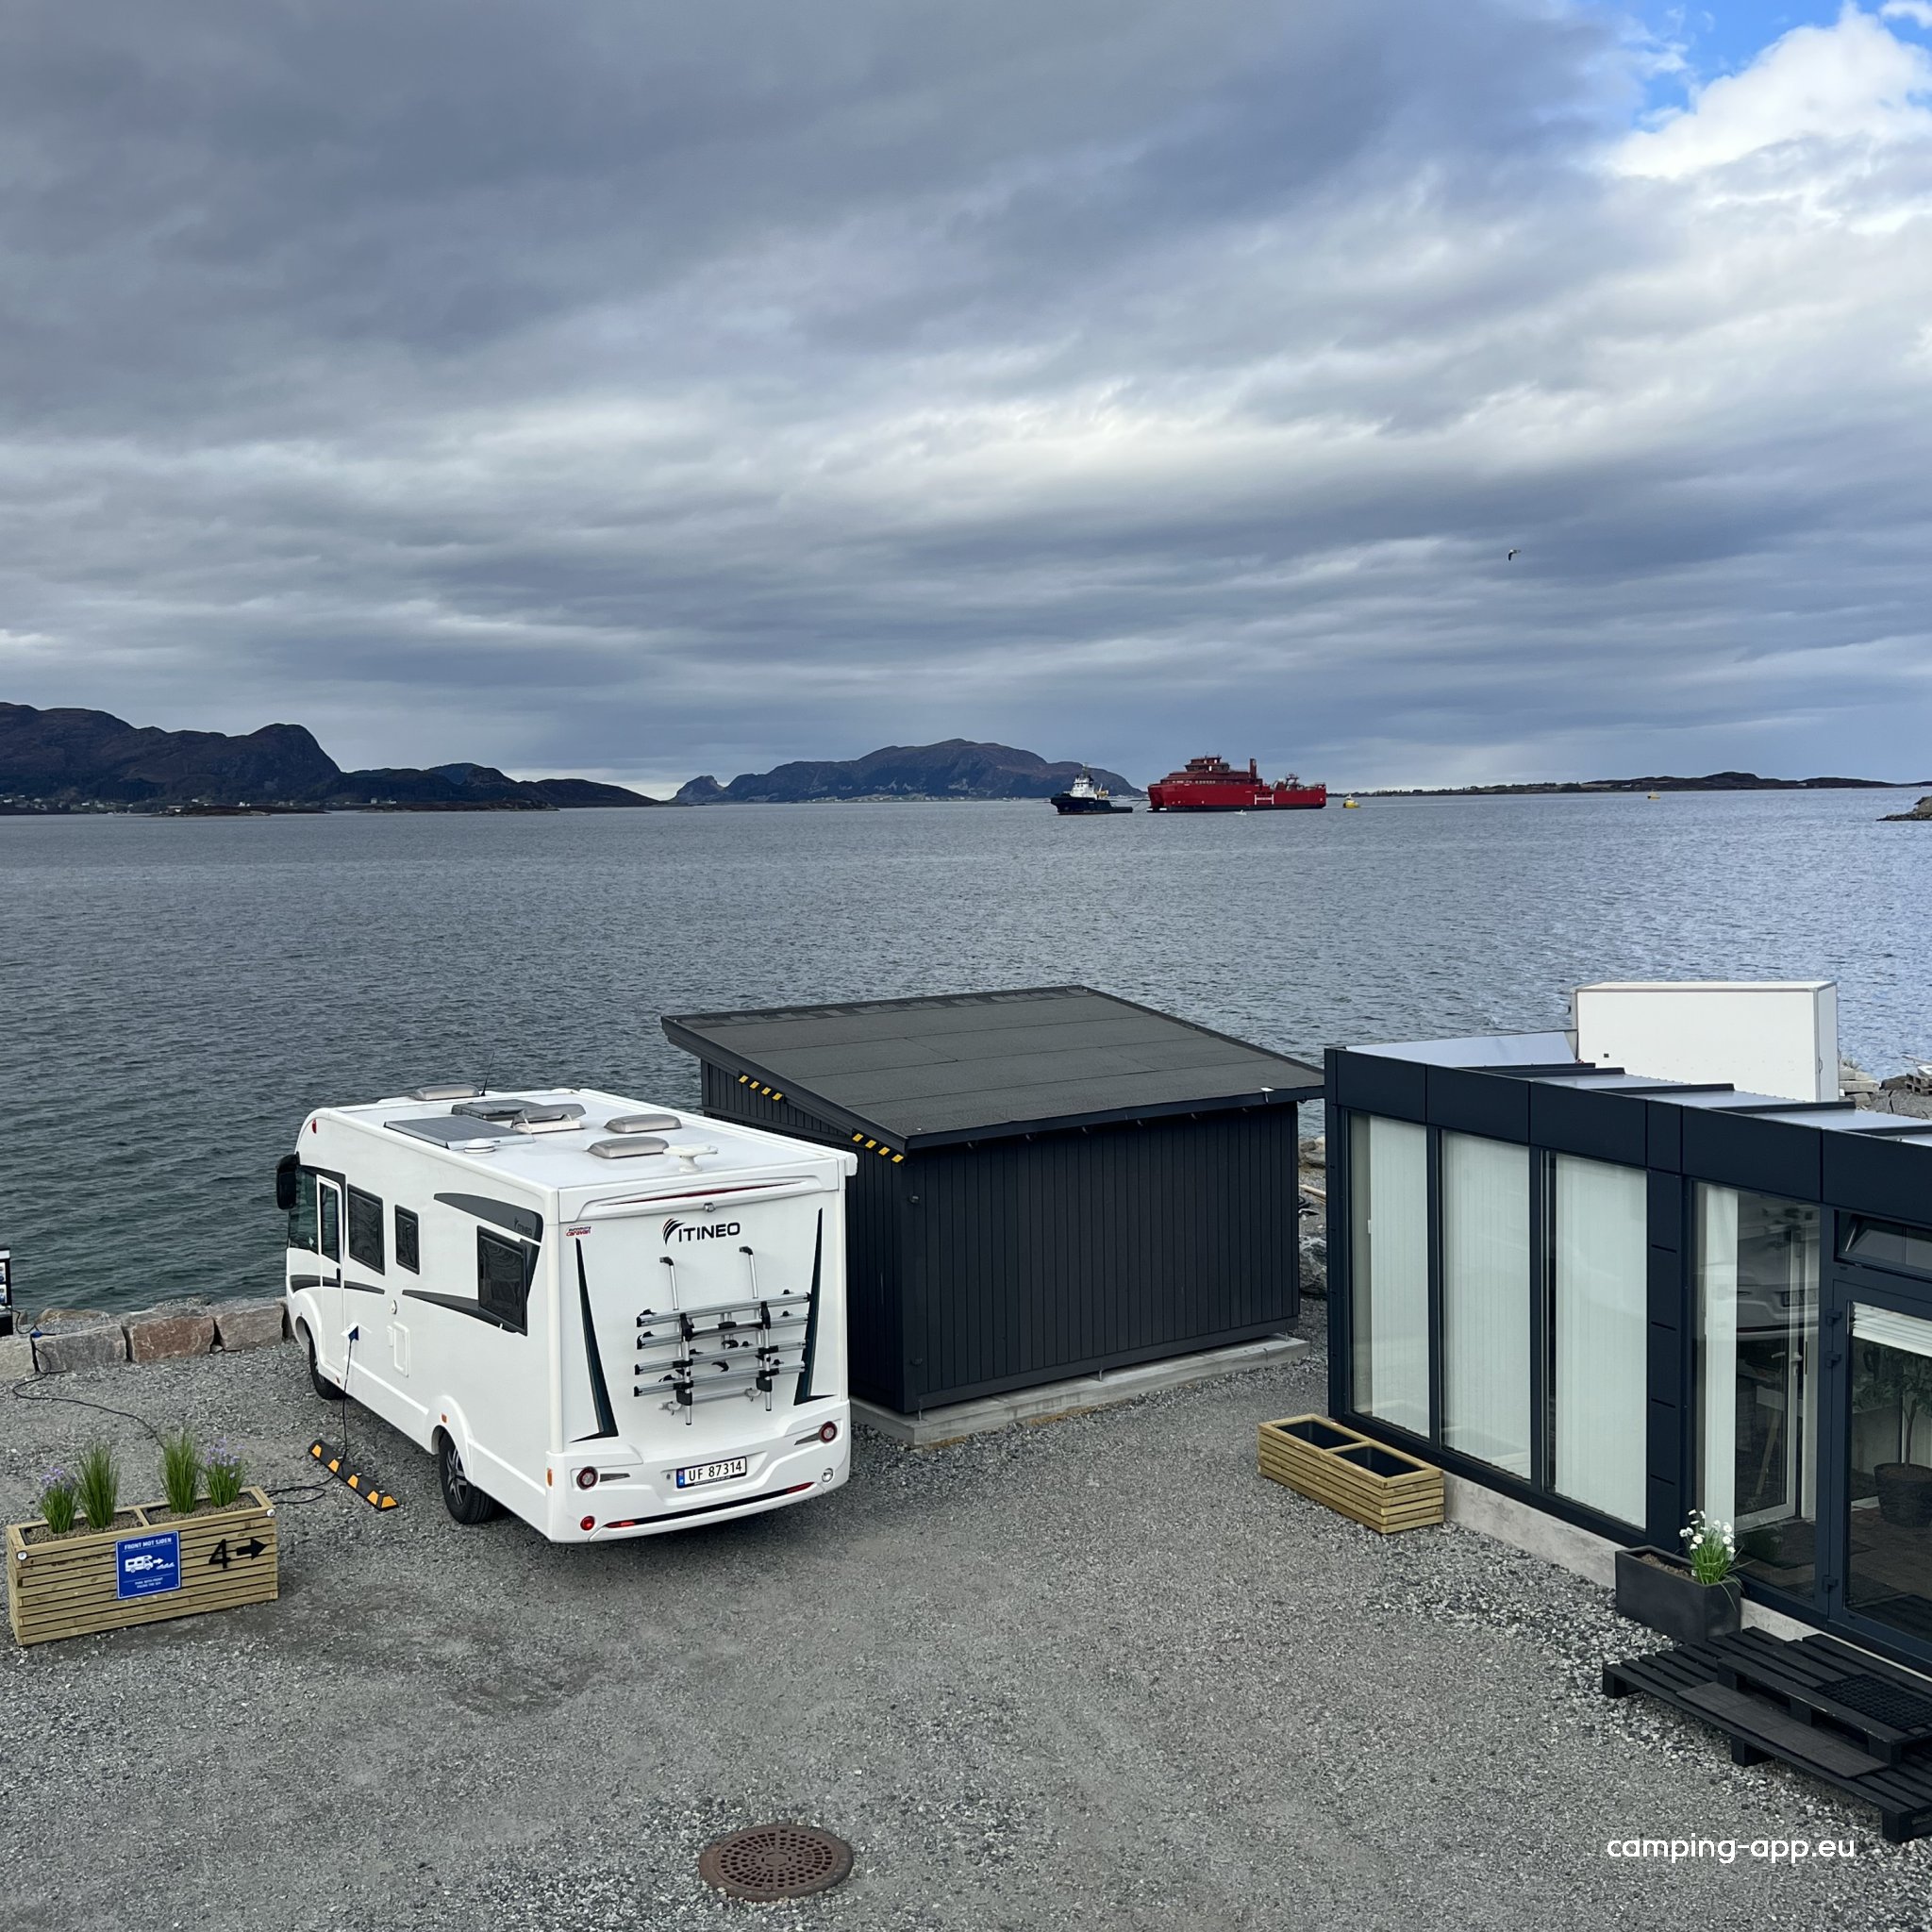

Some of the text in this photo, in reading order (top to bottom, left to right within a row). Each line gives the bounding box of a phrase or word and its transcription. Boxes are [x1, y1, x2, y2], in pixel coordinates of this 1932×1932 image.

[678, 1222, 741, 1242] ITINEO
[689, 1468, 704, 1482] UF
[708, 1460, 742, 1478] 87314
[208, 1539, 231, 1570] 4
